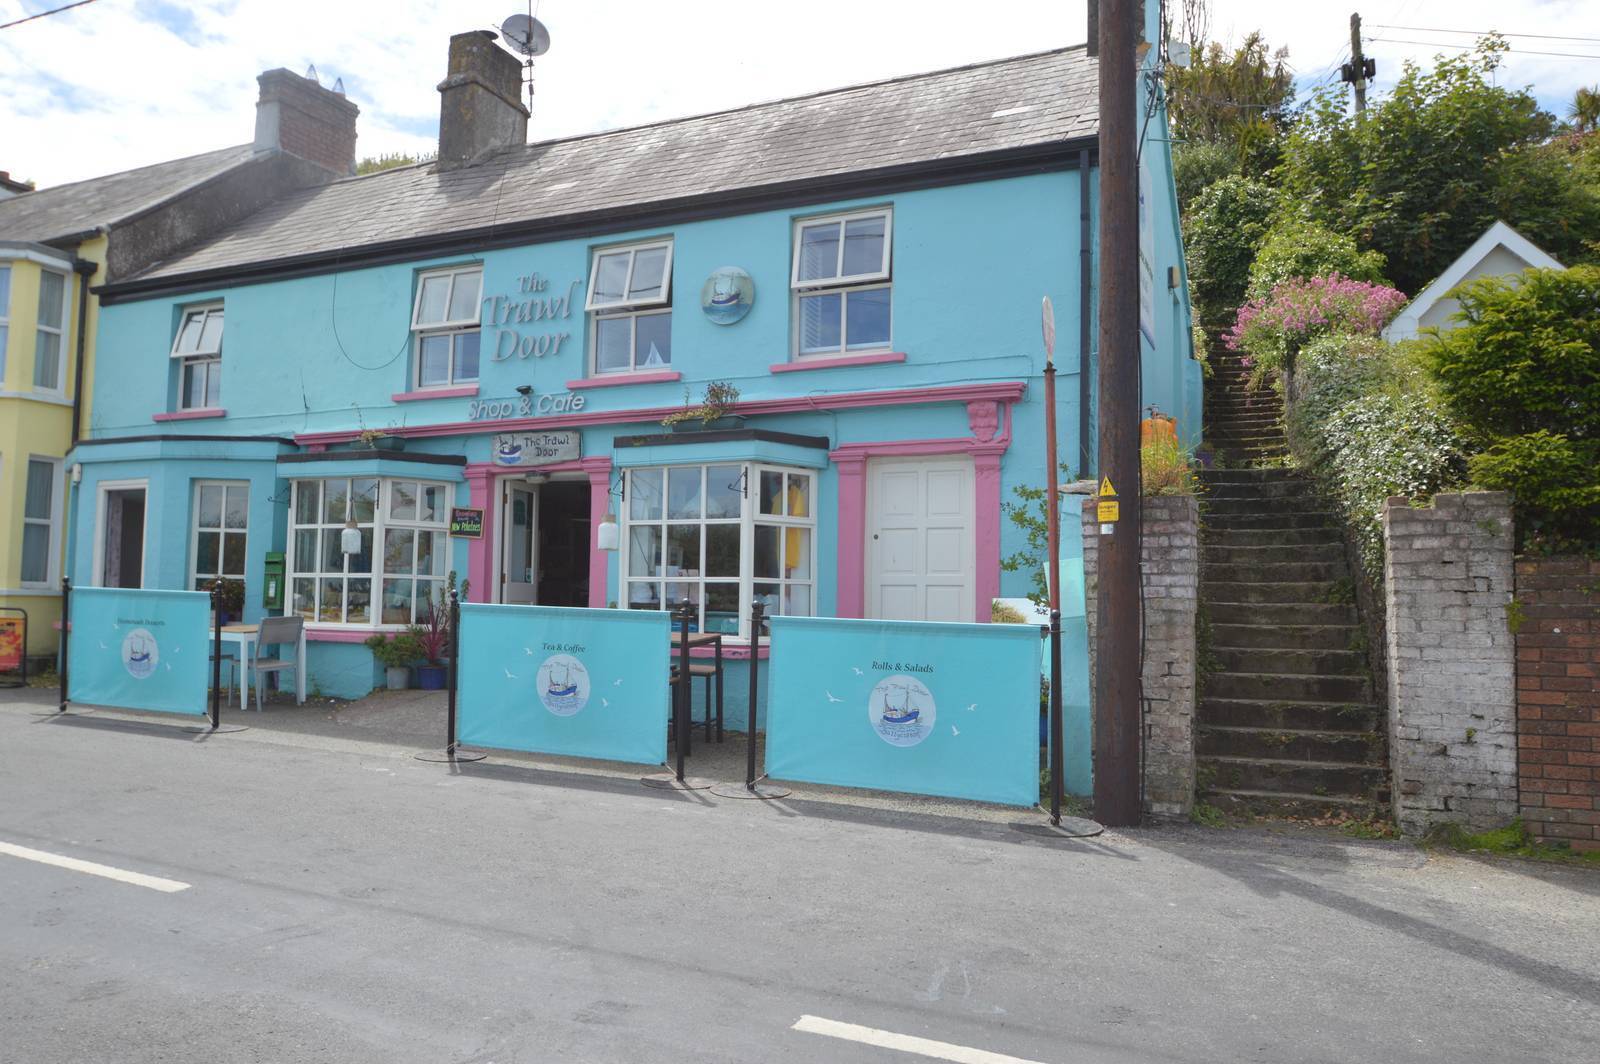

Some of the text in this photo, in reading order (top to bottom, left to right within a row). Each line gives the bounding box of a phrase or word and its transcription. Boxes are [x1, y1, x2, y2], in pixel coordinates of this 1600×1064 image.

[517, 271, 548, 293] The
[483, 277, 582, 326] Trawl
[490, 328, 569, 362] Door
[468, 392, 585, 420] Shop & Cafe
[524, 434, 570, 448] The Trawl
[535, 447, 559, 457] Door
[543, 642, 586, 653] Tea & Coffee
[872, 661, 934, 673] Rolls & Salads
